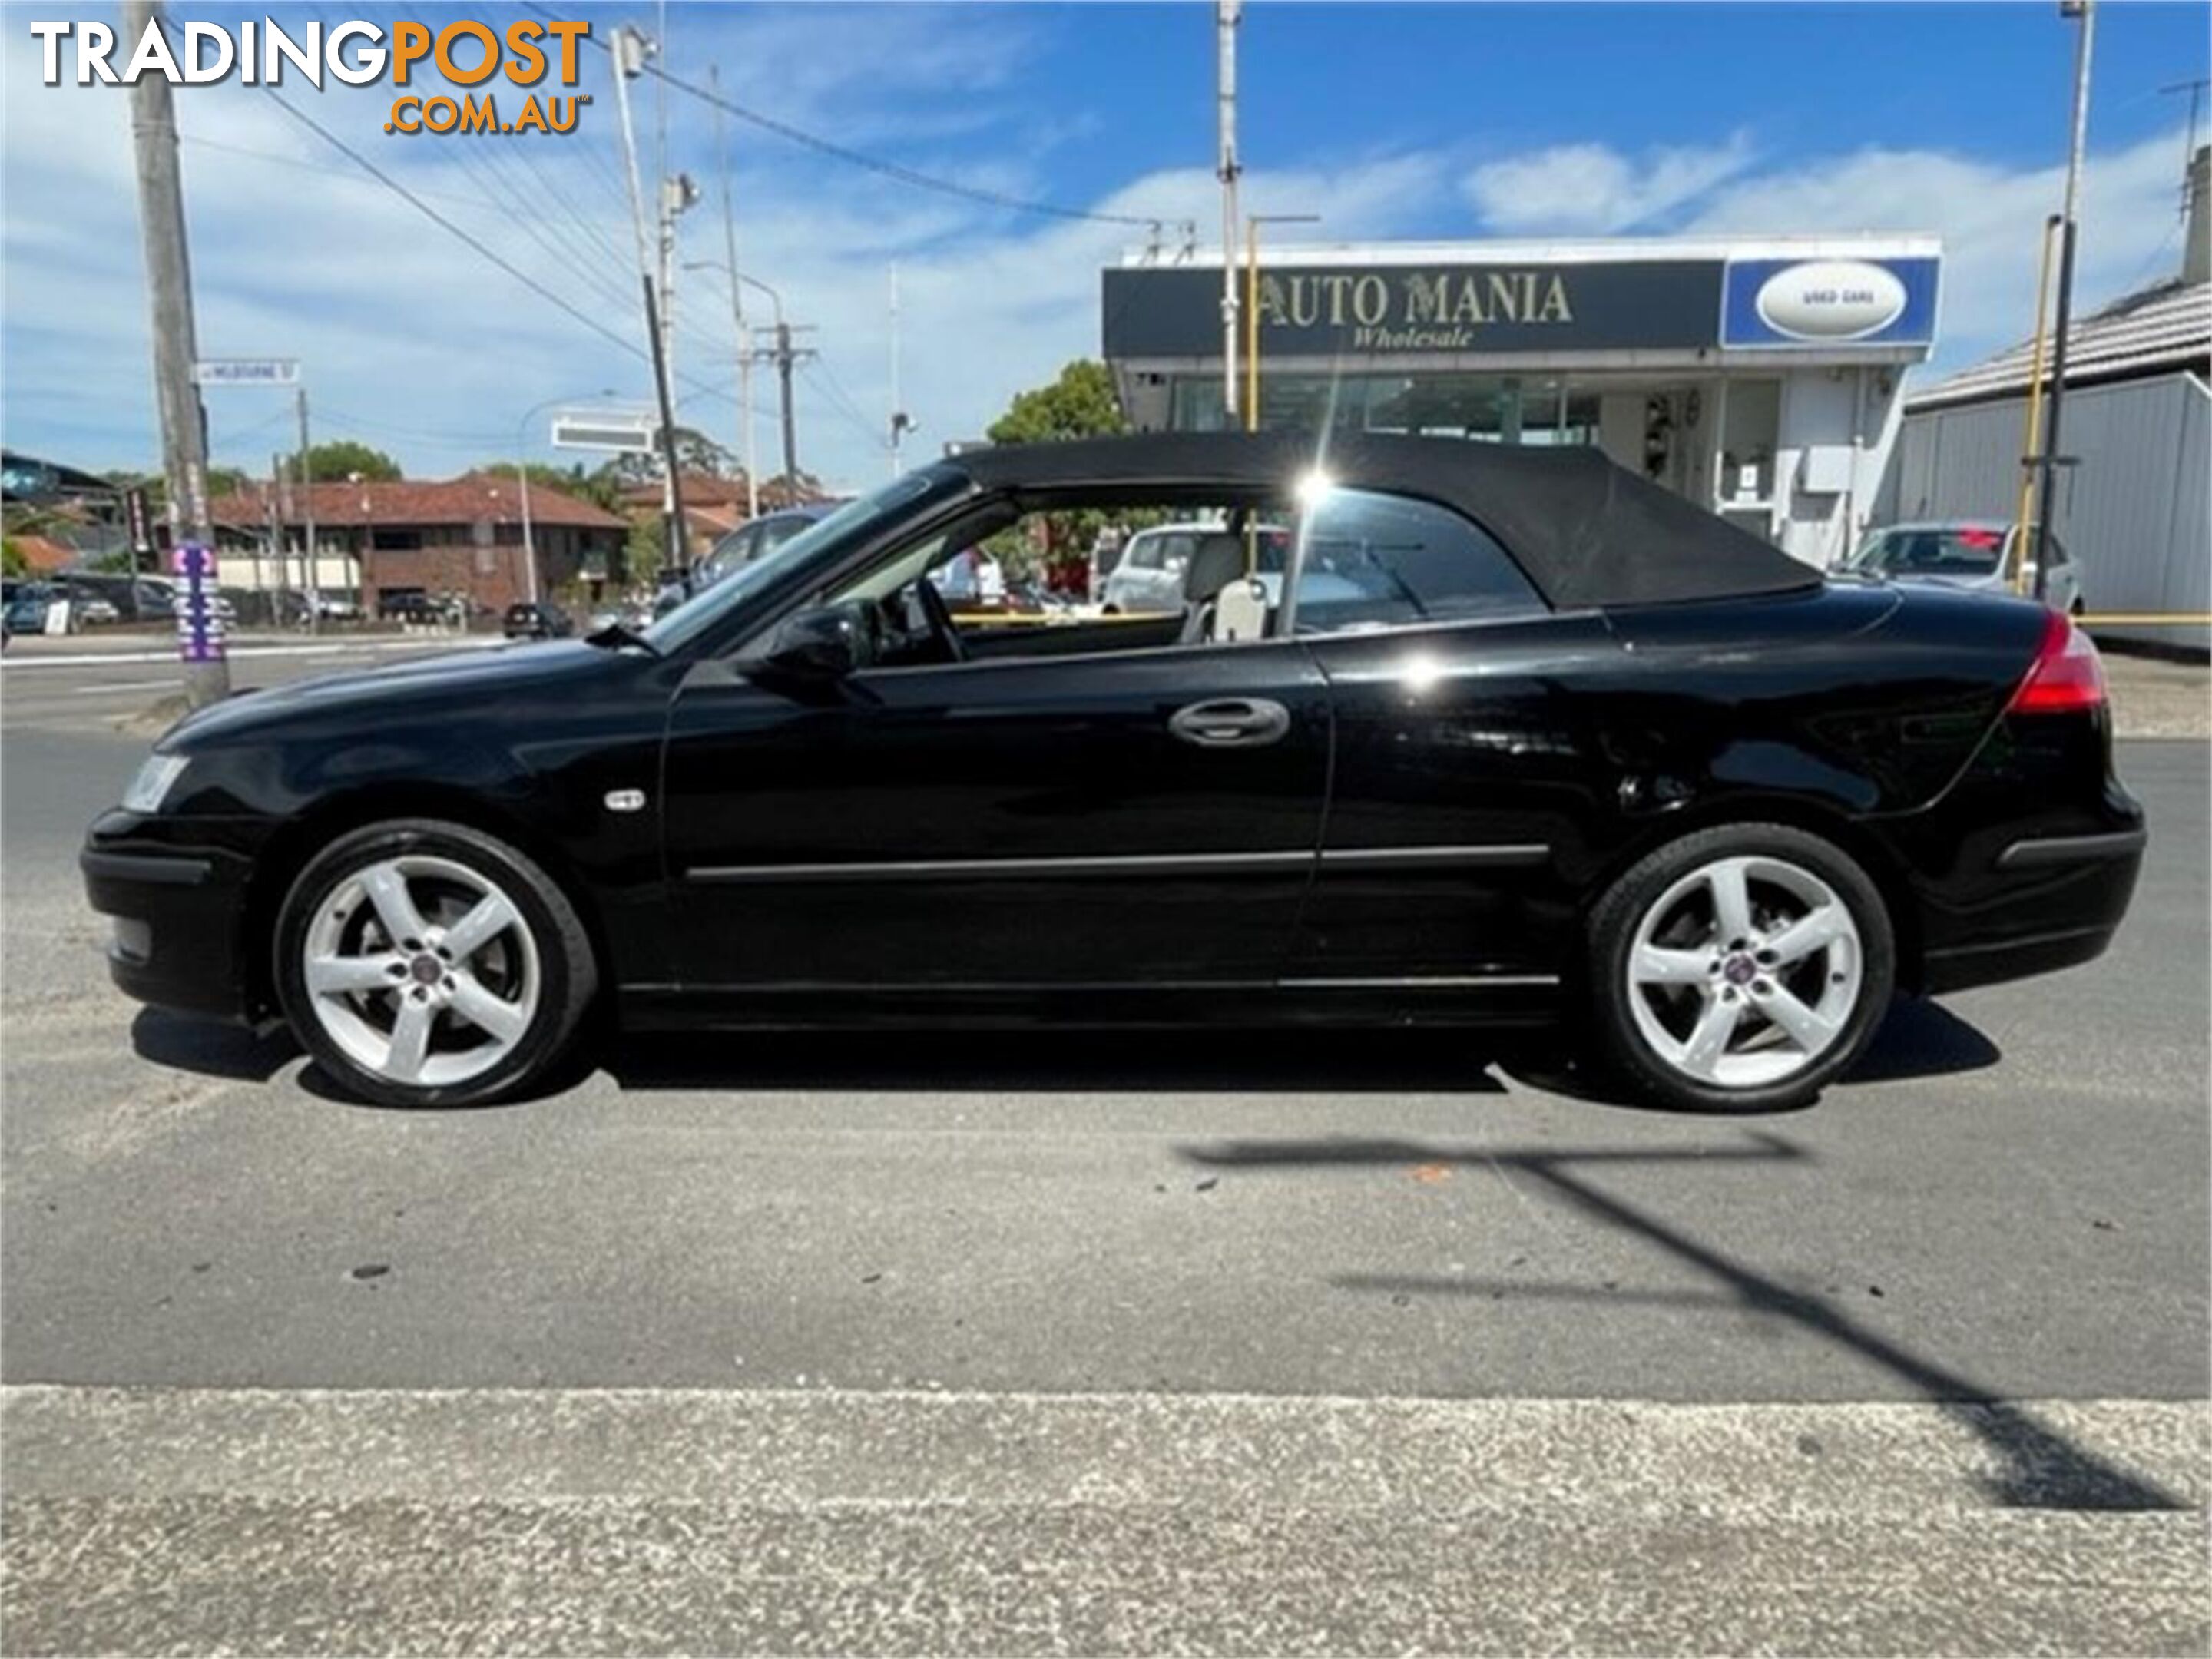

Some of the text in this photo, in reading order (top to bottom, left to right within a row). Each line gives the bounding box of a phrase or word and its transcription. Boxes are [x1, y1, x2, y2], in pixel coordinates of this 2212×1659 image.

[1258, 272, 1572, 326] AUTO MANIA
[1354, 326, 1473, 348] Wholesale
